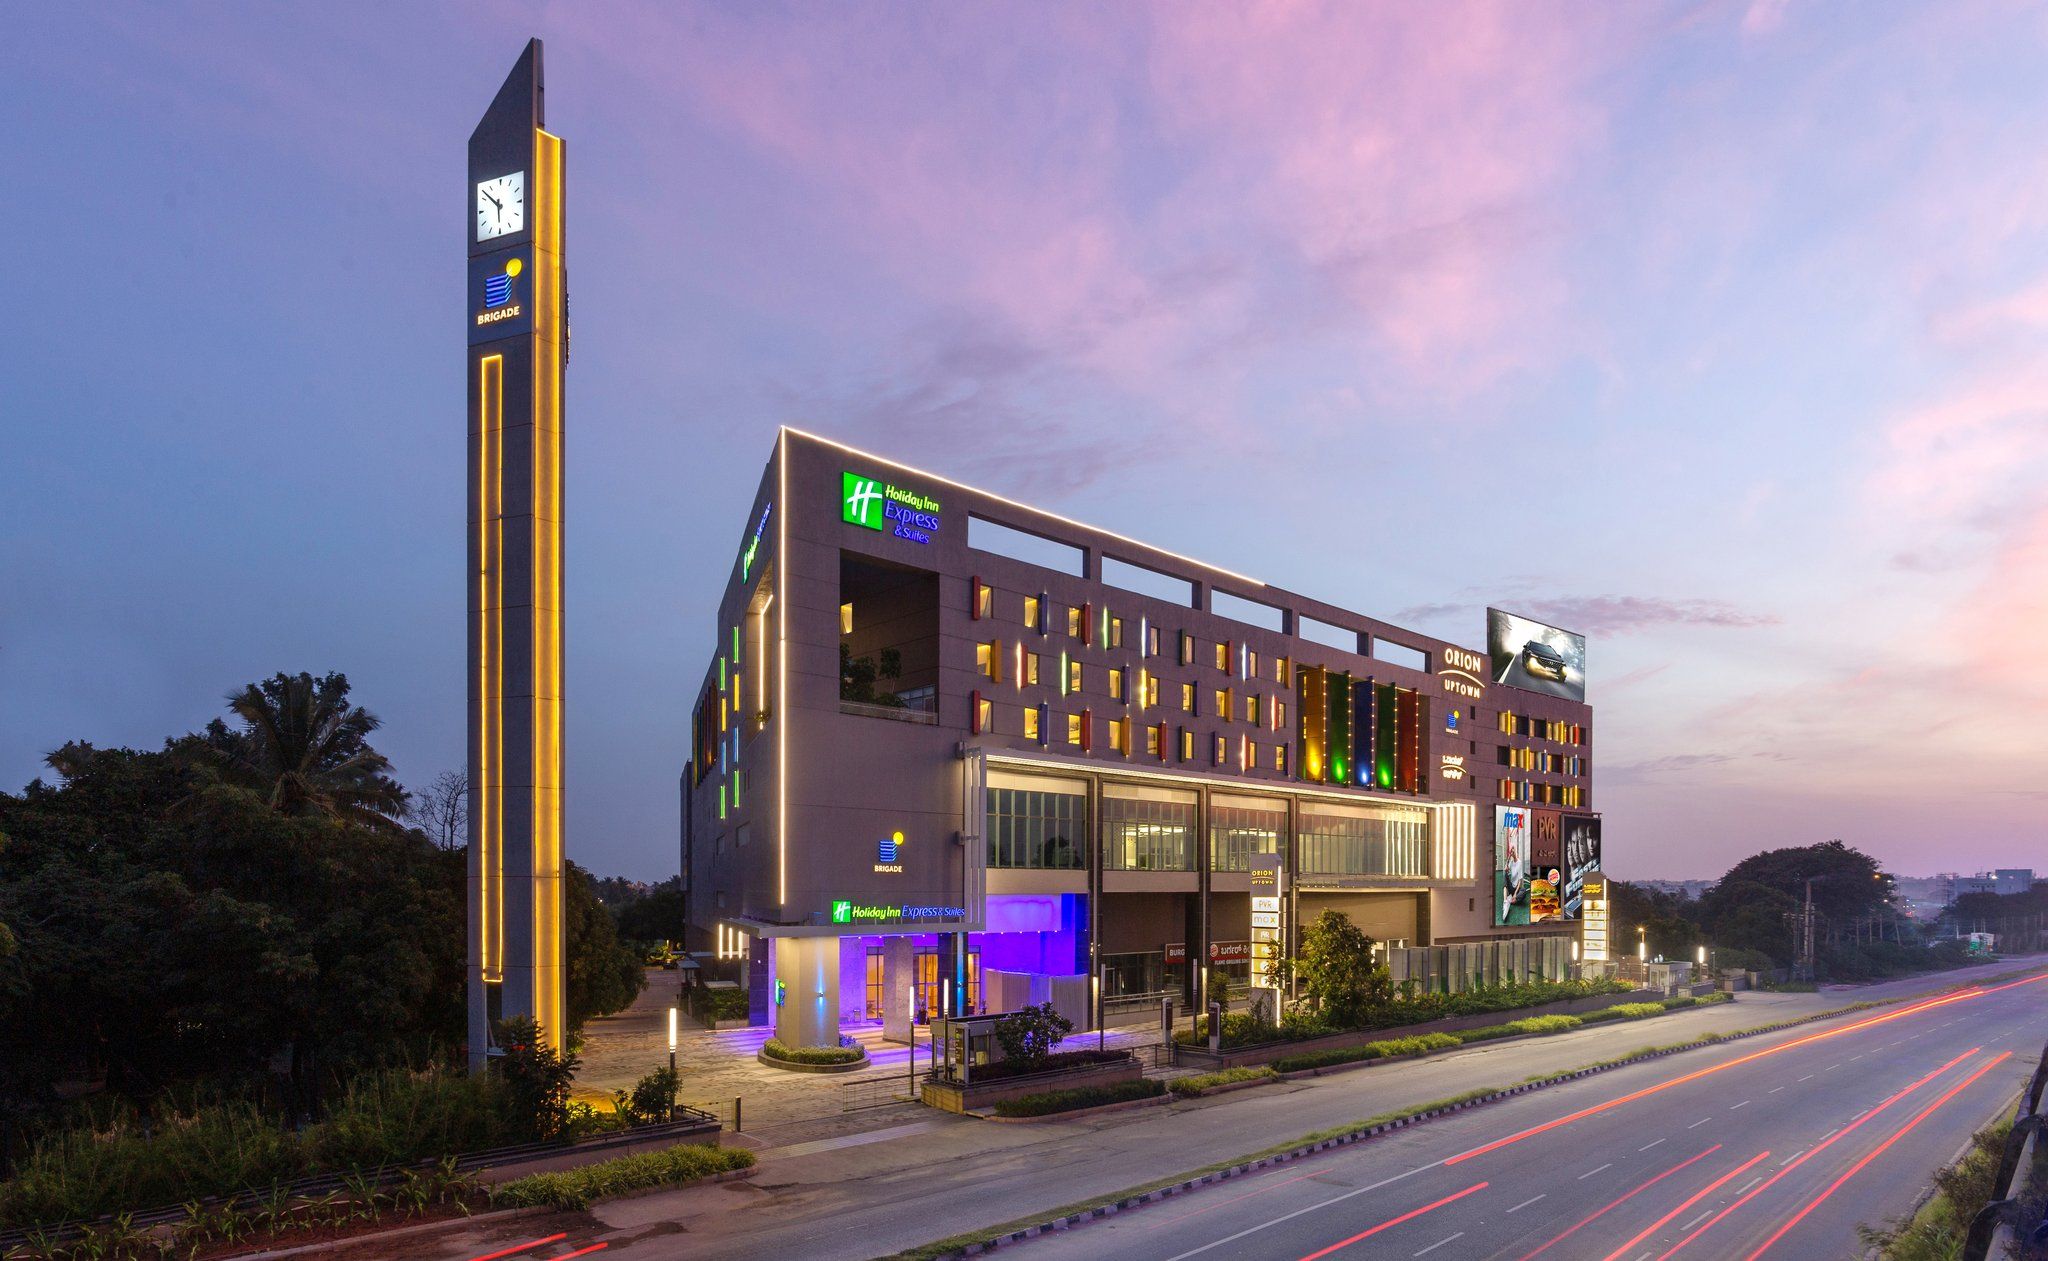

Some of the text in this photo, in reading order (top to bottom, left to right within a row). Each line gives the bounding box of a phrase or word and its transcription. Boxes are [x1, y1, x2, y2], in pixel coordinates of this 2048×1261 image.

[477, 306, 520, 325] BRIGADE
[885, 484, 940, 513] Holiday Inn
[884, 499, 940, 531] Express
[1444, 648, 1481, 673] ORION
[1444, 679, 1481, 699] UPTOWN
[1503, 811, 1524, 828] max
[1538, 815, 1557, 841] PVR
[874, 865, 903, 873] BRIGADE
[852, 906, 887, 920] Holiday
[886, 905, 901, 917] Inn
[902, 905, 937, 919] Express
[944, 906, 965, 916] Suites
